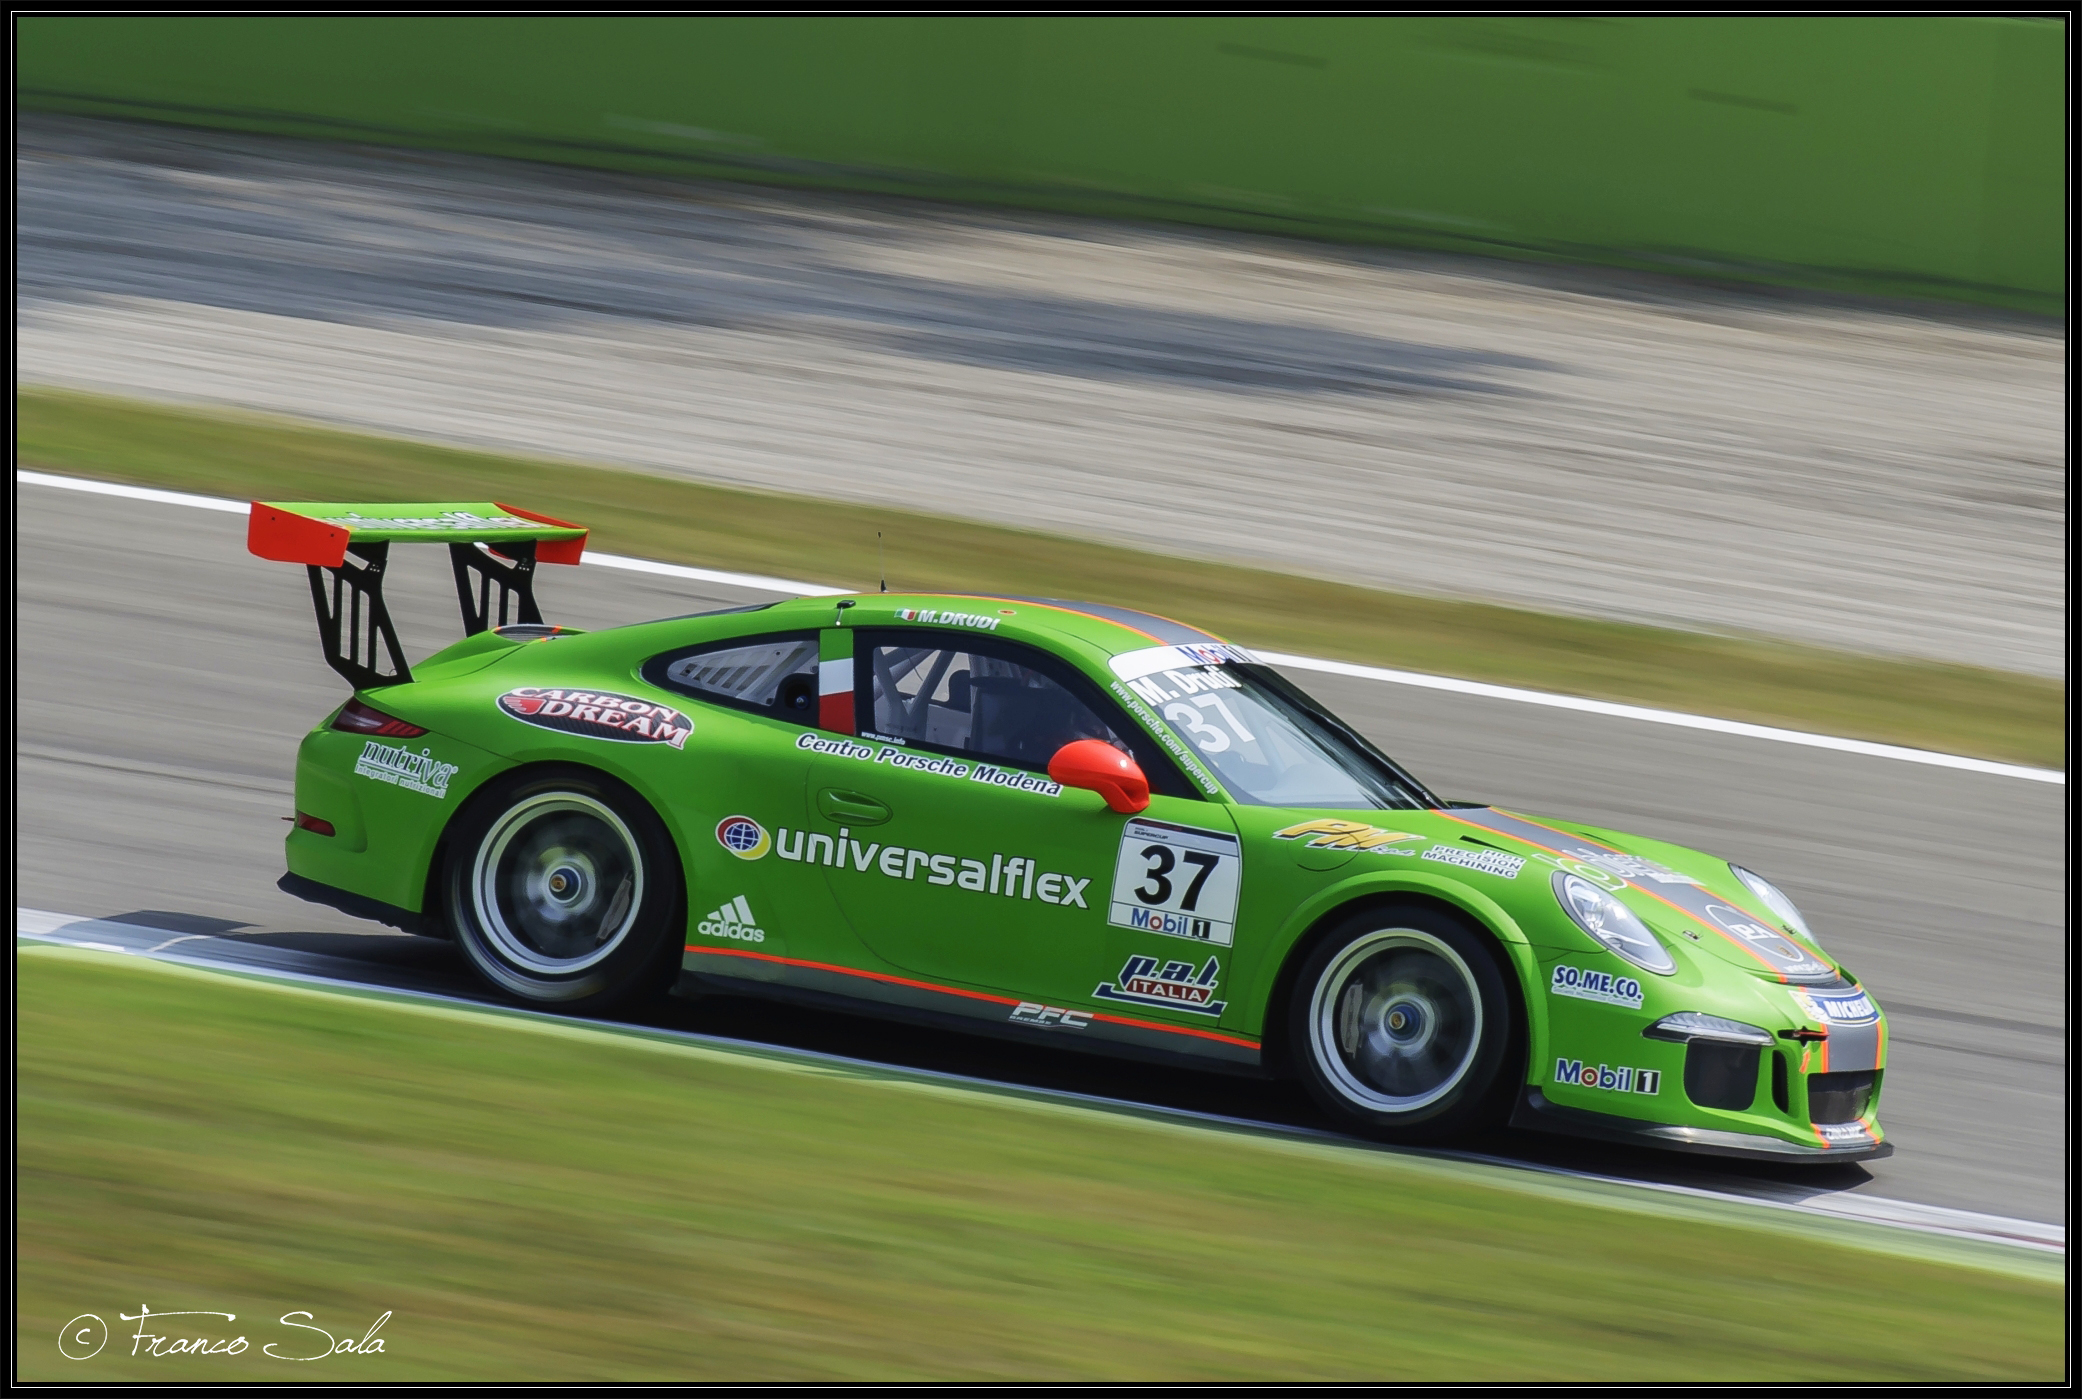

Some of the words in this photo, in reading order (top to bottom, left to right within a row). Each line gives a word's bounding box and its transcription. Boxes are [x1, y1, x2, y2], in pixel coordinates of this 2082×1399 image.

[917, 609, 1001, 630] M.DRUDI
[1126, 676, 1181, 707] M.
[1162, 664, 1242, 694] Drudi
[511, 688, 680, 721] CARBON
[539, 700, 691, 747] DREAM
[1110, 681, 1218, 795] www.porsche.com/supercup
[1163, 692, 1256, 753] 37
[797, 733, 872, 760] Centro
[876, 747, 968, 777] Porsche
[971, 763, 1062, 796] Modena
[776, 827, 1092, 909] universalflex
[1423, 852, 1516, 878] MACHINING
[1434, 846, 1521, 869] PRECISION
[1484, 850, 1524, 863] HIGH
[1134, 844, 1220, 912] 37
[698, 920, 765, 943] adidas
[1131, 908, 1188, 935] Mobil
[1132, 980, 1203, 1002] ITALIA
[1553, 966, 1643, 1000] SO.ME.CO.
[1011, 1002, 1095, 1027] PFC
[1555, 1058, 1632, 1092] Mobil
